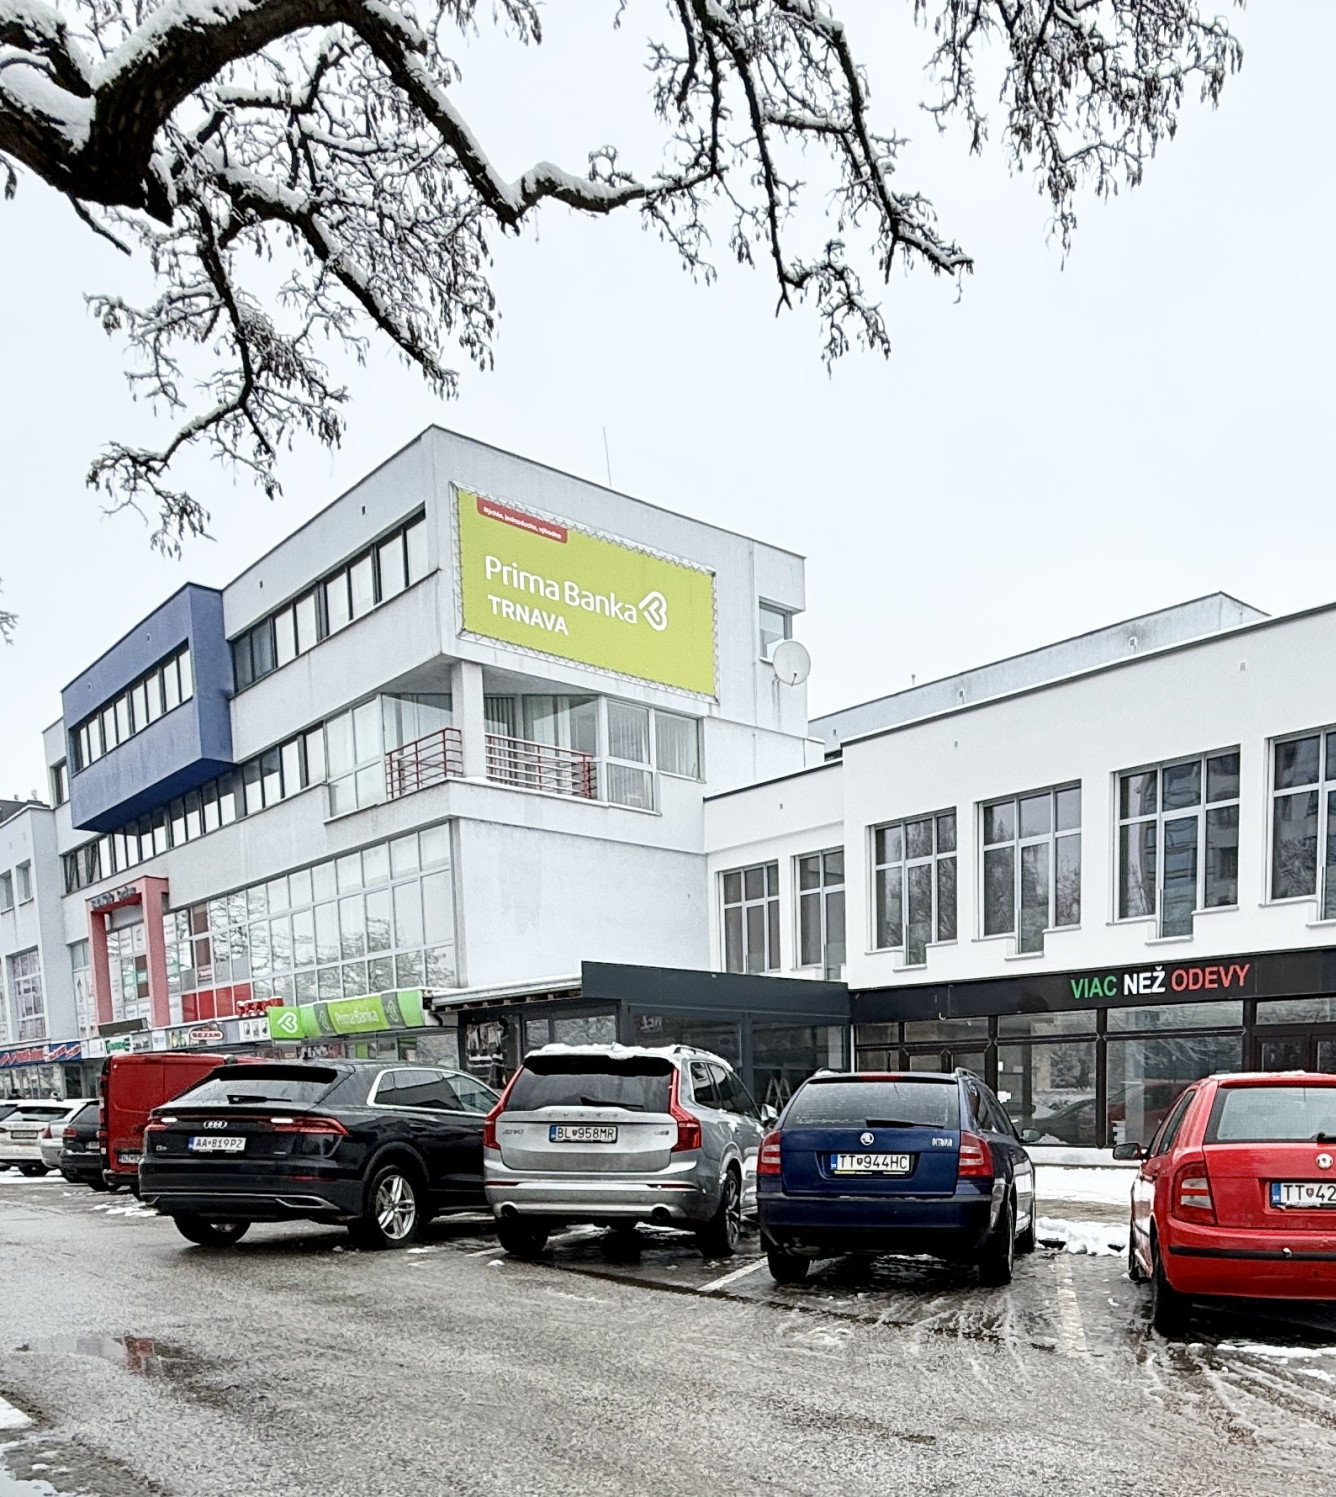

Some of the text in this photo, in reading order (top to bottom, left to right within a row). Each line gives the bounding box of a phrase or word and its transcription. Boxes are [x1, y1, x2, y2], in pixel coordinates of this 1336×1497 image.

[485, 555, 637, 624] Prima Banka
[488, 594, 569, 636] TRNAVA
[1071, 963, 1250, 999] VIAC NEŽ ODEVY
